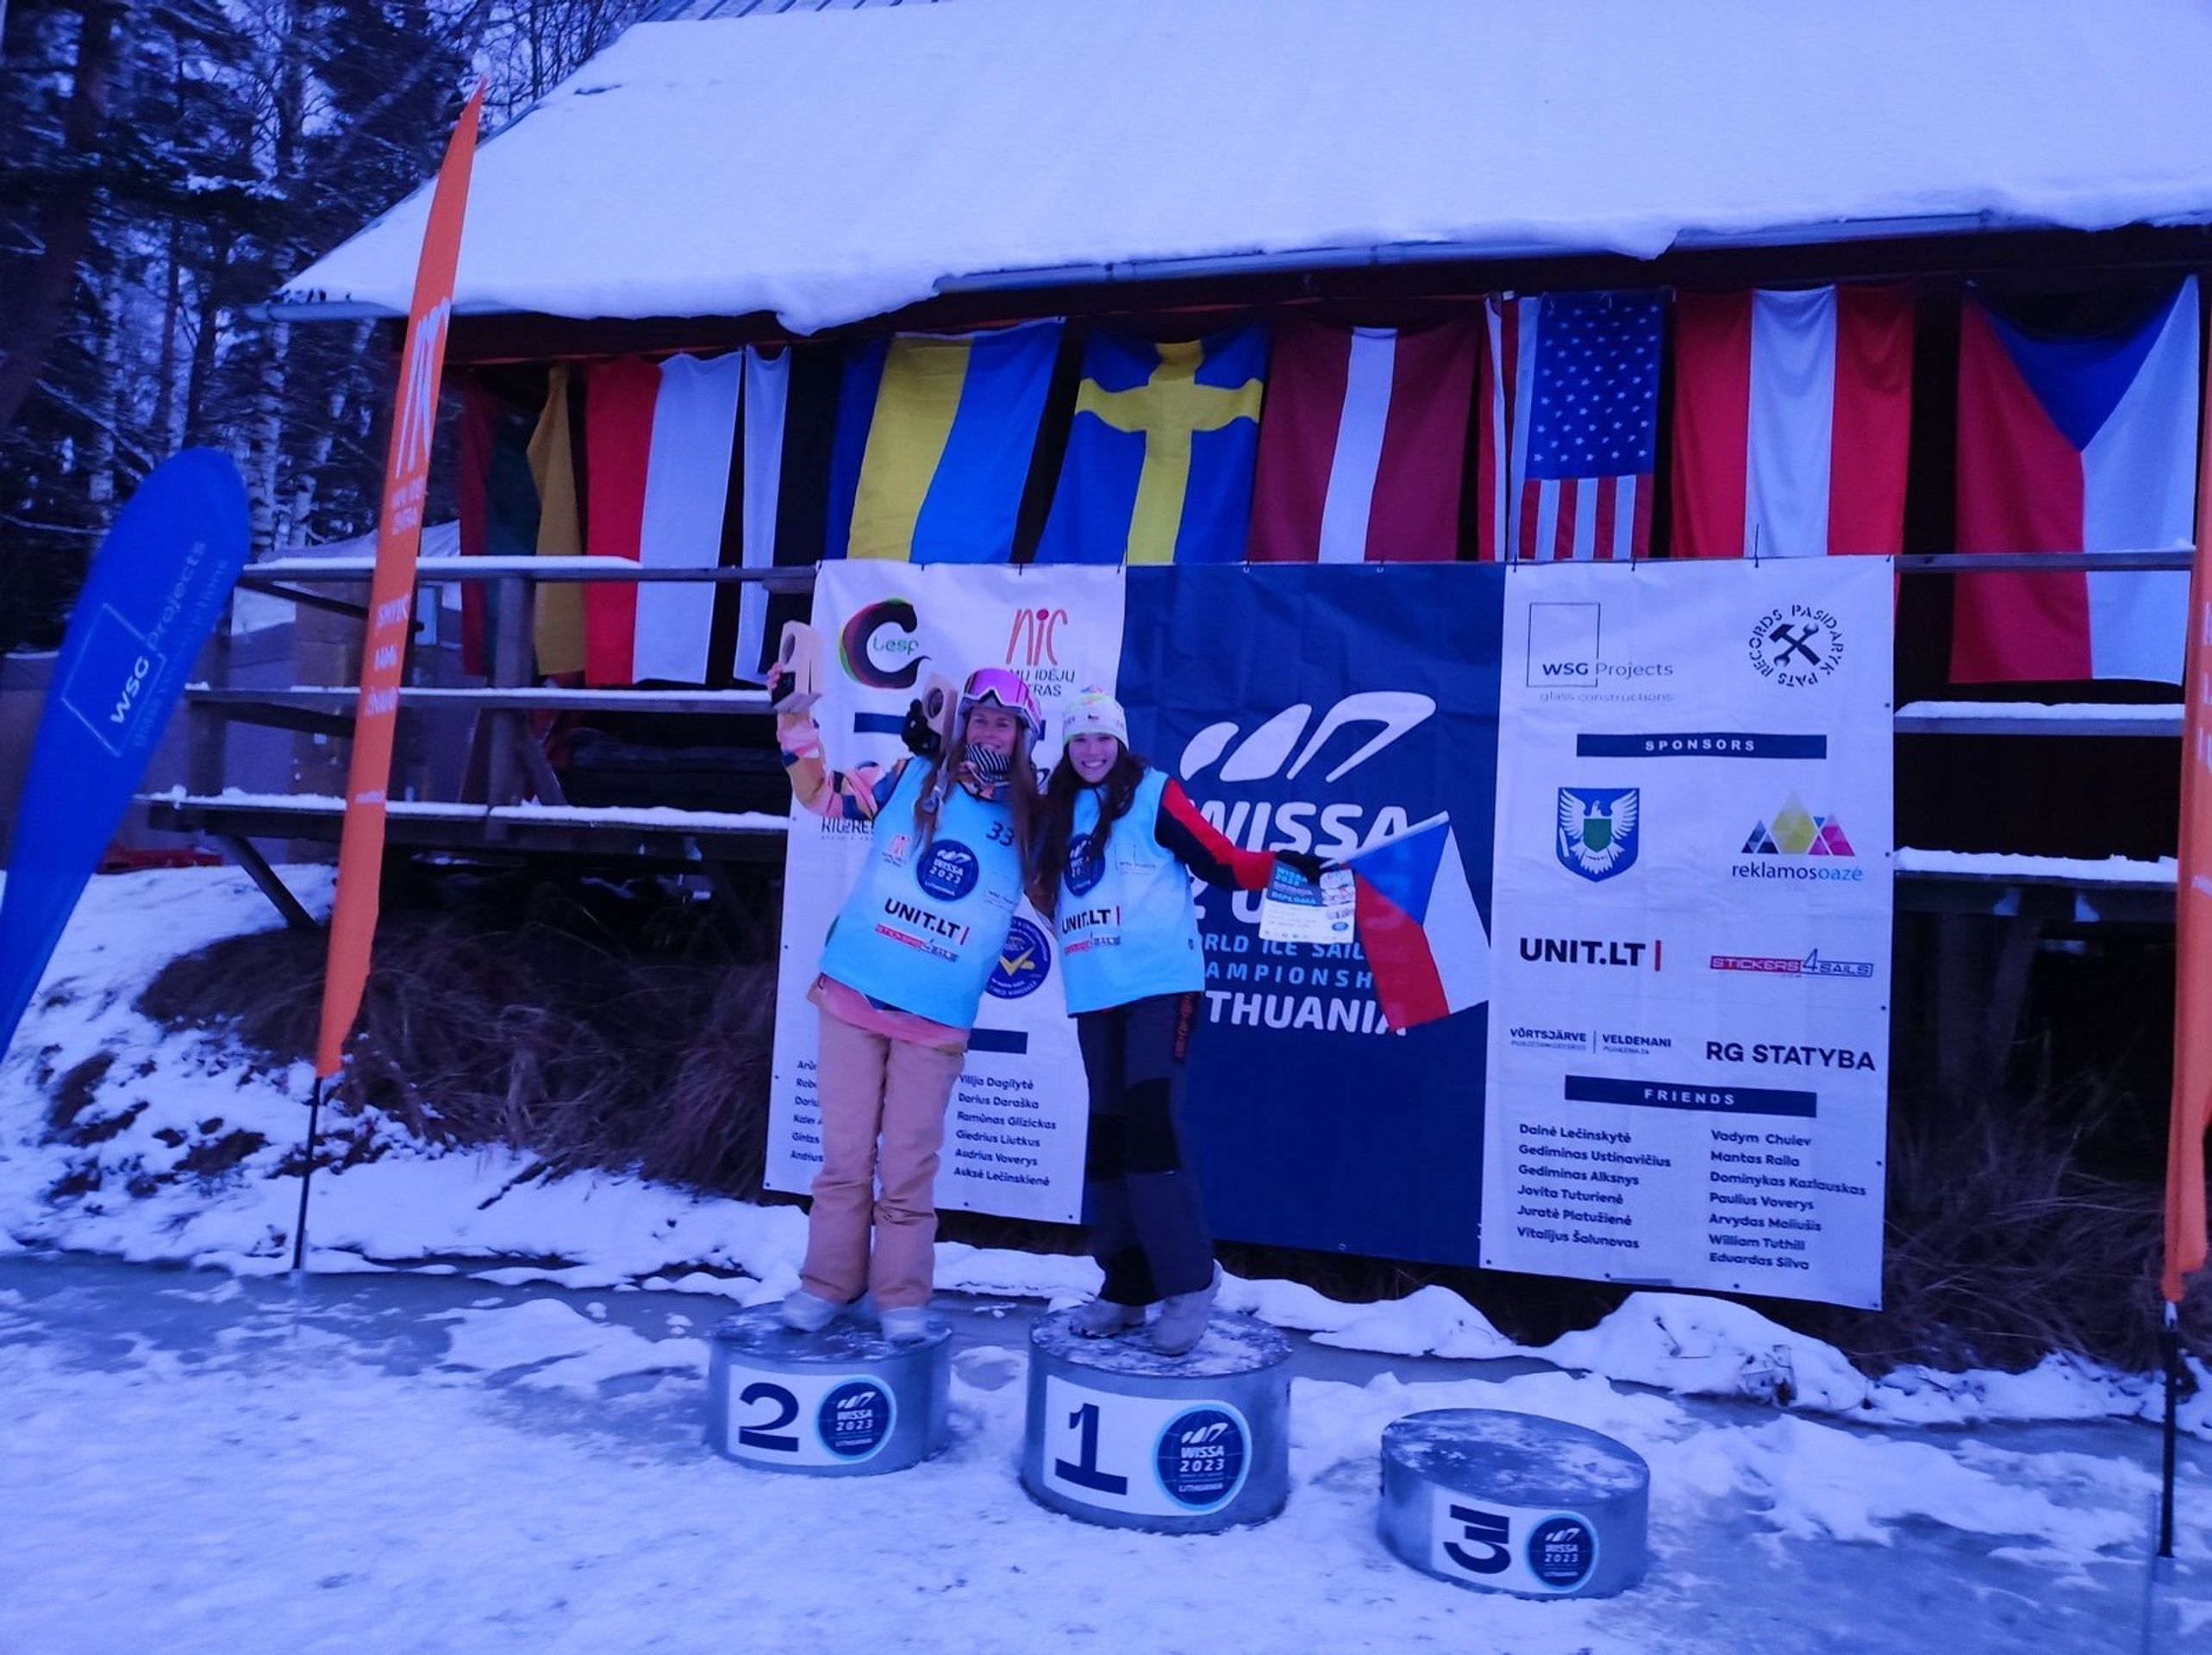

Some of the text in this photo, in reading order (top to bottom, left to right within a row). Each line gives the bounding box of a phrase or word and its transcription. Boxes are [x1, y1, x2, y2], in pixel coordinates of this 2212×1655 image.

[110, 655, 149, 723] WSG
[147, 541, 206, 651] Projects
[1749, 609, 1782, 677] RECORDS
[1542, 661, 1673, 679] WSG Projects
[1540, 690, 1674, 703] glass constructions
[1645, 739, 1756, 753] SPONSORS
[986, 821, 1015, 847] 33
[884, 898, 960, 940] UNIT.LT
[1061, 909, 1111, 934] UNIT.LT
[1203, 934, 1250, 953] RLD
[1312, 942, 1365, 960] SAIL
[1520, 938, 1646, 966] UNIT.LT
[1205, 961, 1374, 990] AMPIONSH
[1706, 1040, 1876, 1071] RG STATYBA
[959, 1092, 990, 1105] Darius
[1644, 1089, 1735, 1105] FRIENDS
[955, 1129, 1040, 1147] Giedrius Liutkus
[1560, 1127, 1631, 1145] Lečinskytė
[1710, 1129, 1759, 1145] Vadym
[1519, 1144, 1671, 1167] Gediminas Ustinavičius
[1710, 1151, 1762, 1164] Mantas
[1518, 1164, 1640, 1187] Gediminas Alksnys
[1709, 1171, 1866, 1196] Dominykas Kazlauskas
[1517, 1184, 1558, 1198] Jovita
[1709, 1192, 1815, 1211] Paulius Voverys
[1709, 1213, 1765, 1228] Arvydas
[1516, 1226, 1570, 1243] Vitalijus
[1709, 1233, 1806, 1251] William Tuthill
[1709, 1252, 1809, 1270] Eduardas Silva
[739, 1383, 799, 1452] 2
[836, 1408, 873, 1421] WISSA
[835, 1420, 873, 1432] 2023
[1055, 1402, 1128, 1496] 1
[1180, 1446, 1225, 1459] WISSA
[1178, 1458, 1225, 1472] 2023
[1442, 1504, 1512, 1574] 3
[1545, 1544, 1579, 1552] WISSA
[1544, 1553, 1579, 1563] 2023
